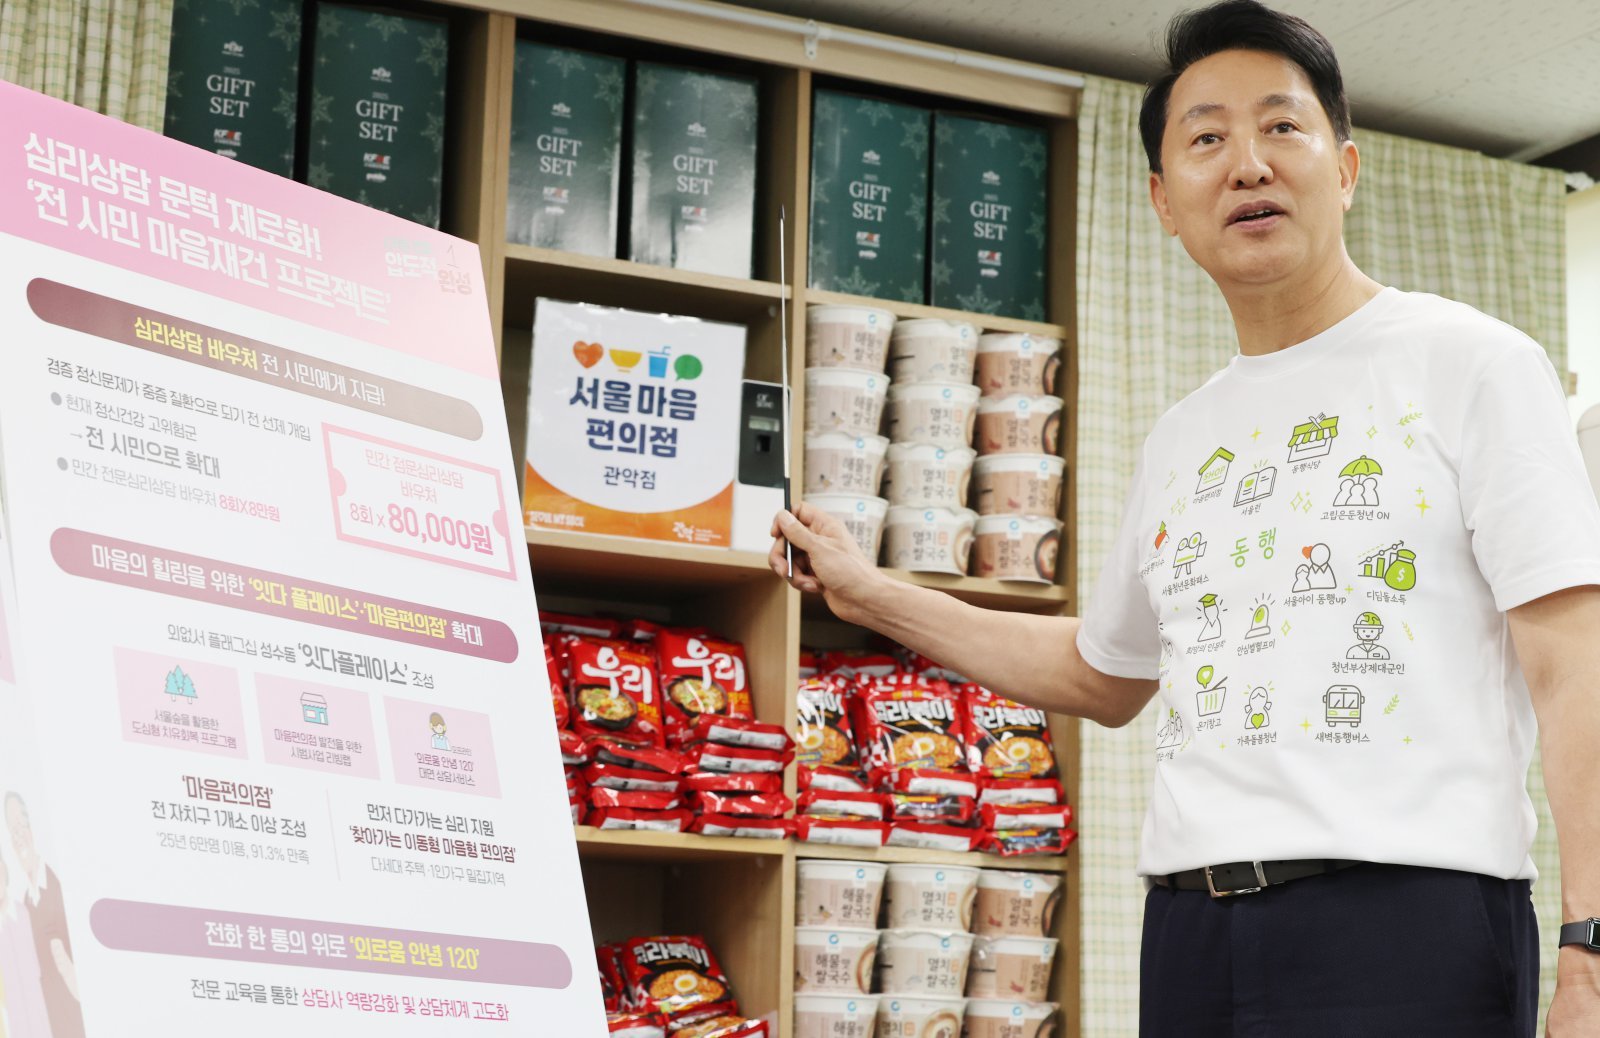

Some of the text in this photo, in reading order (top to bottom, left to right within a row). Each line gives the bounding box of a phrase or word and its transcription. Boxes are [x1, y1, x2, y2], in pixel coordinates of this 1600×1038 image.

[206, 74, 256, 97] GIFT
[209, 96, 250, 118] SET
[355, 99, 404, 122] GIFT
[359, 121, 398, 142] SET
[536, 134, 582, 157] GIFT
[540, 155, 576, 177] SET
[673, 154, 718, 176] GIFT
[24, 132, 322, 260] 심리상담 문턱 제로화!
[676, 175, 713, 196] SET
[848, 181, 892, 203] GIFT
[852, 201, 887, 222] SET
[969, 200, 1011, 221] GIFT
[78, 196, 140, 248] 시민
[148, 216, 269, 288] 마음재건
[973, 220, 1008, 240] SET
[134, 317, 385, 407] 심리상담 바우처 전 시민에게 지급!
[47, 358, 311, 441] 경증 정신문제가 중증 질환으로 되기 전 선제 개입
[66, 394, 197, 442] 현재 정신건강 고위험군
[586, 418, 678, 459] 편의점
[86, 426, 221, 479] 전 시민으로 확대
[72, 459, 98, 480] 민간
[101, 465, 176, 498] 전문심리상담
[180, 485, 217, 508] 바우처
[603, 466, 656, 490] 관악점
[1202, 465, 1227, 480] SHOP
[401, 480, 438, 504] 바우처
[1320, 510, 1390, 522] 고립은둔청년 ON
[350, 503, 374, 527] 8회
[388, 503, 494, 556] 80,000원
[1229, 527, 1277, 569] 동행
[92, 544, 147, 577] 마음의
[152, 557, 206, 589] 힐링을
[211, 570, 245, 597] 위한
[451, 621, 483, 647] 확대
[1283, 593, 1347, 607] 서울아이 동행up
[1366, 590, 1407, 606] 디딤돌소득
[208, 632, 257, 656] 플래그십
[260, 641, 296, 664] 성수동
[411, 671, 435, 690] 조성
[672, 638, 745, 691] 우리
[1331, 661, 1405, 675] 청년부상제대군인
[581, 646, 652, 704] 우리
[1315, 732, 1371, 744] 새벽동행버스
[151, 800, 307, 839] 전 자치구 1개소 이상 조성
[367, 803, 495, 838] 먼저 다가가는 심리 지원
[189, 836, 221, 854] 6만명
[250, 844, 285, 862] 91.3%
[287, 848, 310, 865] 만족
[404, 833, 440, 854] 이동형
[442, 838, 478, 859] 마음형
[371, 856, 403, 873] 다세대
[405, 860, 426, 877] 주택
[466, 868, 506, 886] 밀집지역
[204, 921, 243, 949] 전화
[247, 925, 266, 950] 한
[270, 927, 308, 955] 통의
[311, 930, 348, 958] 위로
[408, 942, 443, 968] 안녕
[192, 978, 509, 1022] 전문 교육을 통한 상담사 역량강화 및 상담체계 고도화
